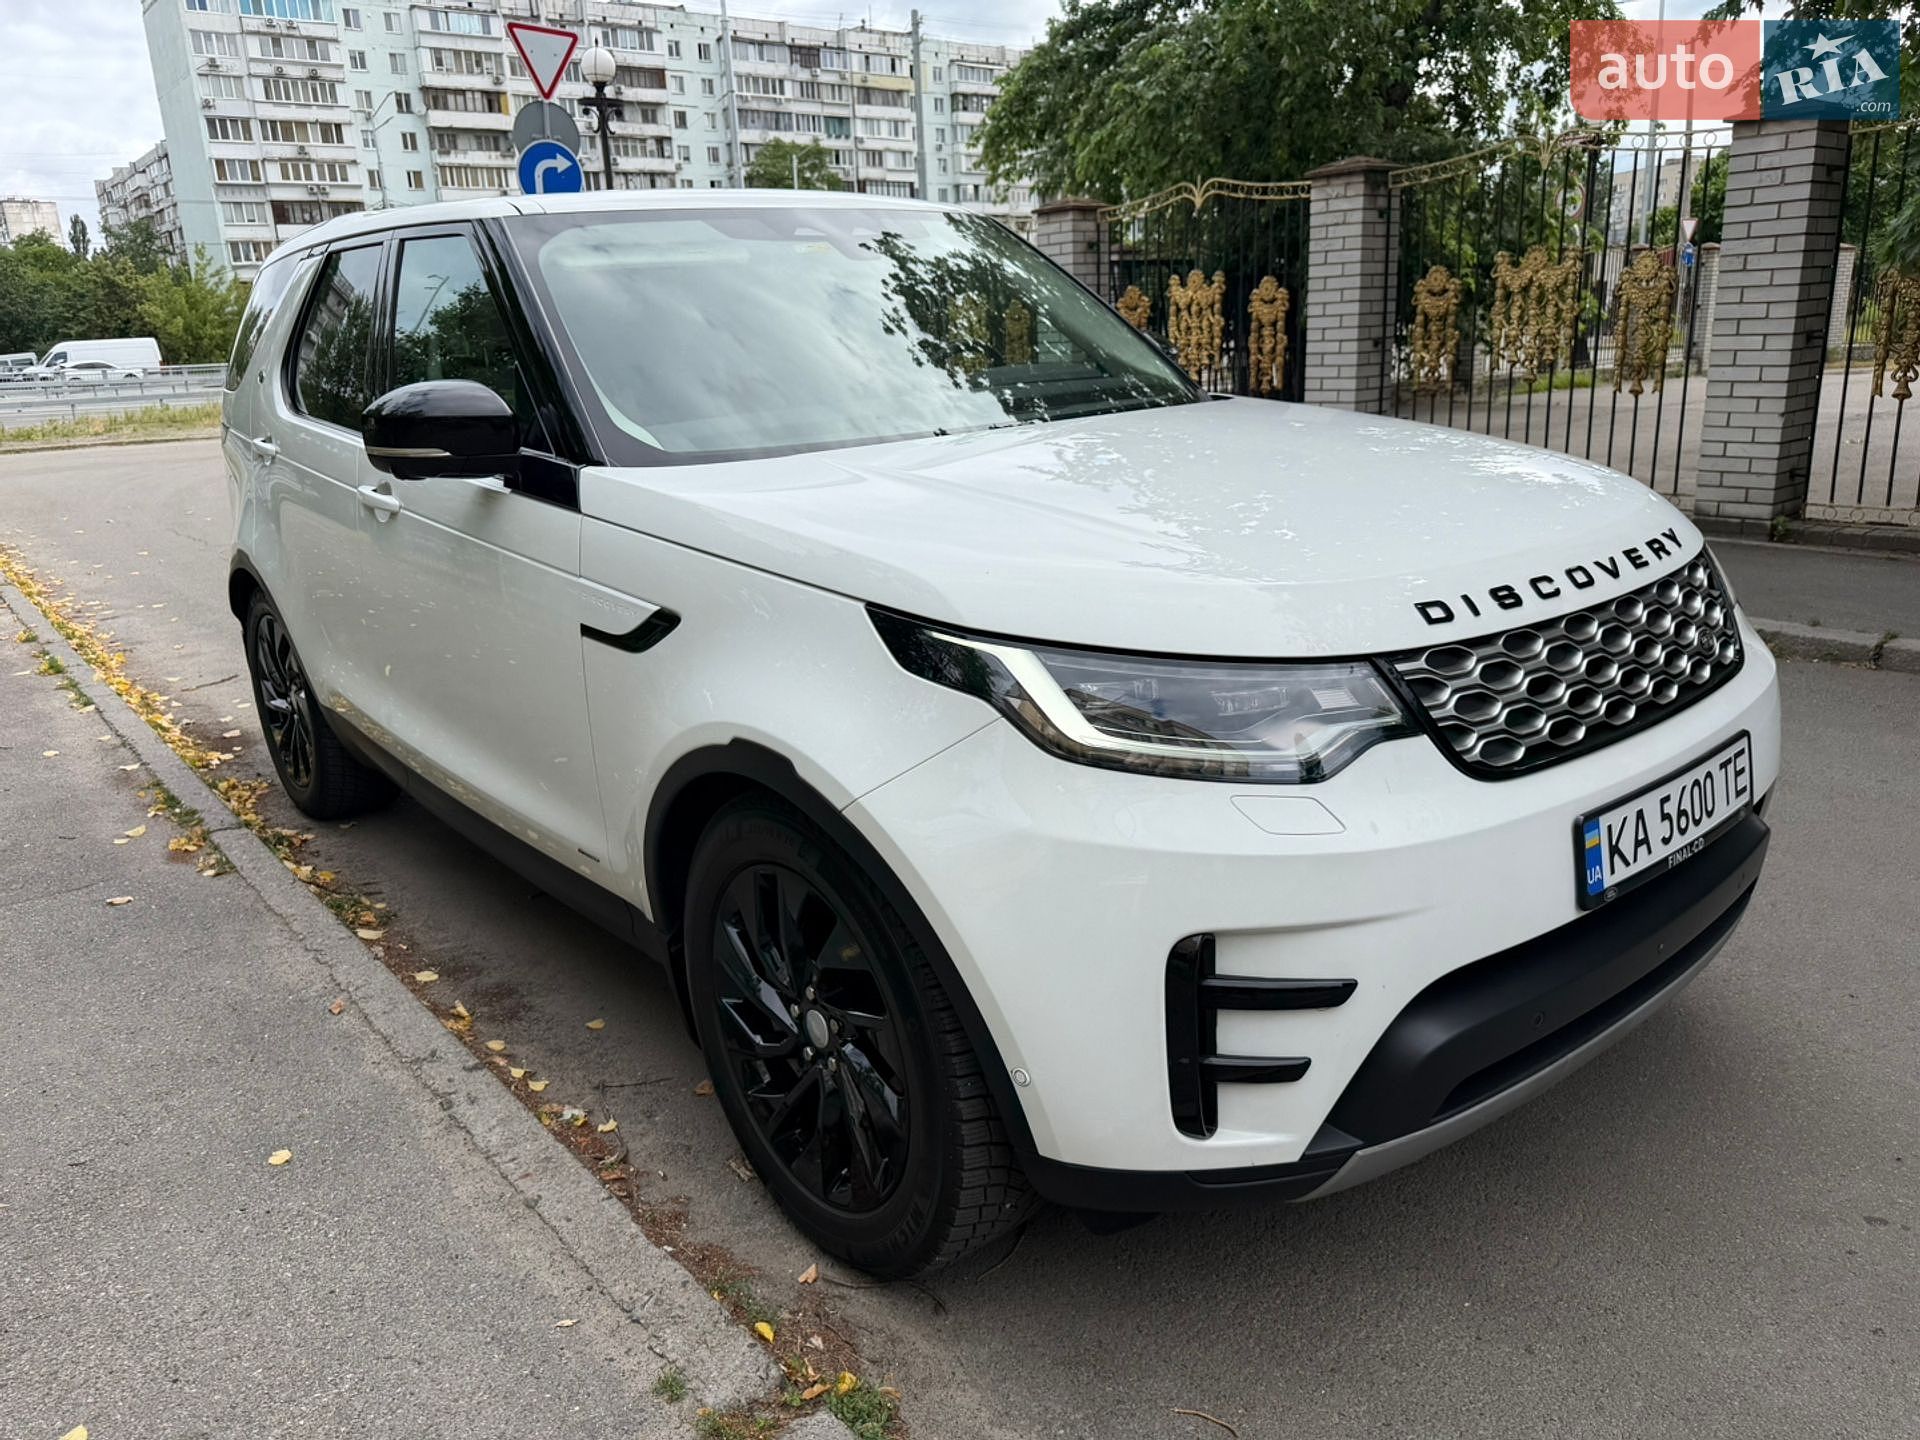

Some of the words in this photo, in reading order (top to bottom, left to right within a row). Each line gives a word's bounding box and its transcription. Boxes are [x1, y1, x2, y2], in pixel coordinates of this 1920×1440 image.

[1413, 527, 1683, 625] DISCOVERY
[1607, 808, 1652, 876] KA
[1660, 771, 1716, 846] 5600
[1719, 747, 1748, 806] TE
[1587, 866, 1602, 884] UA
